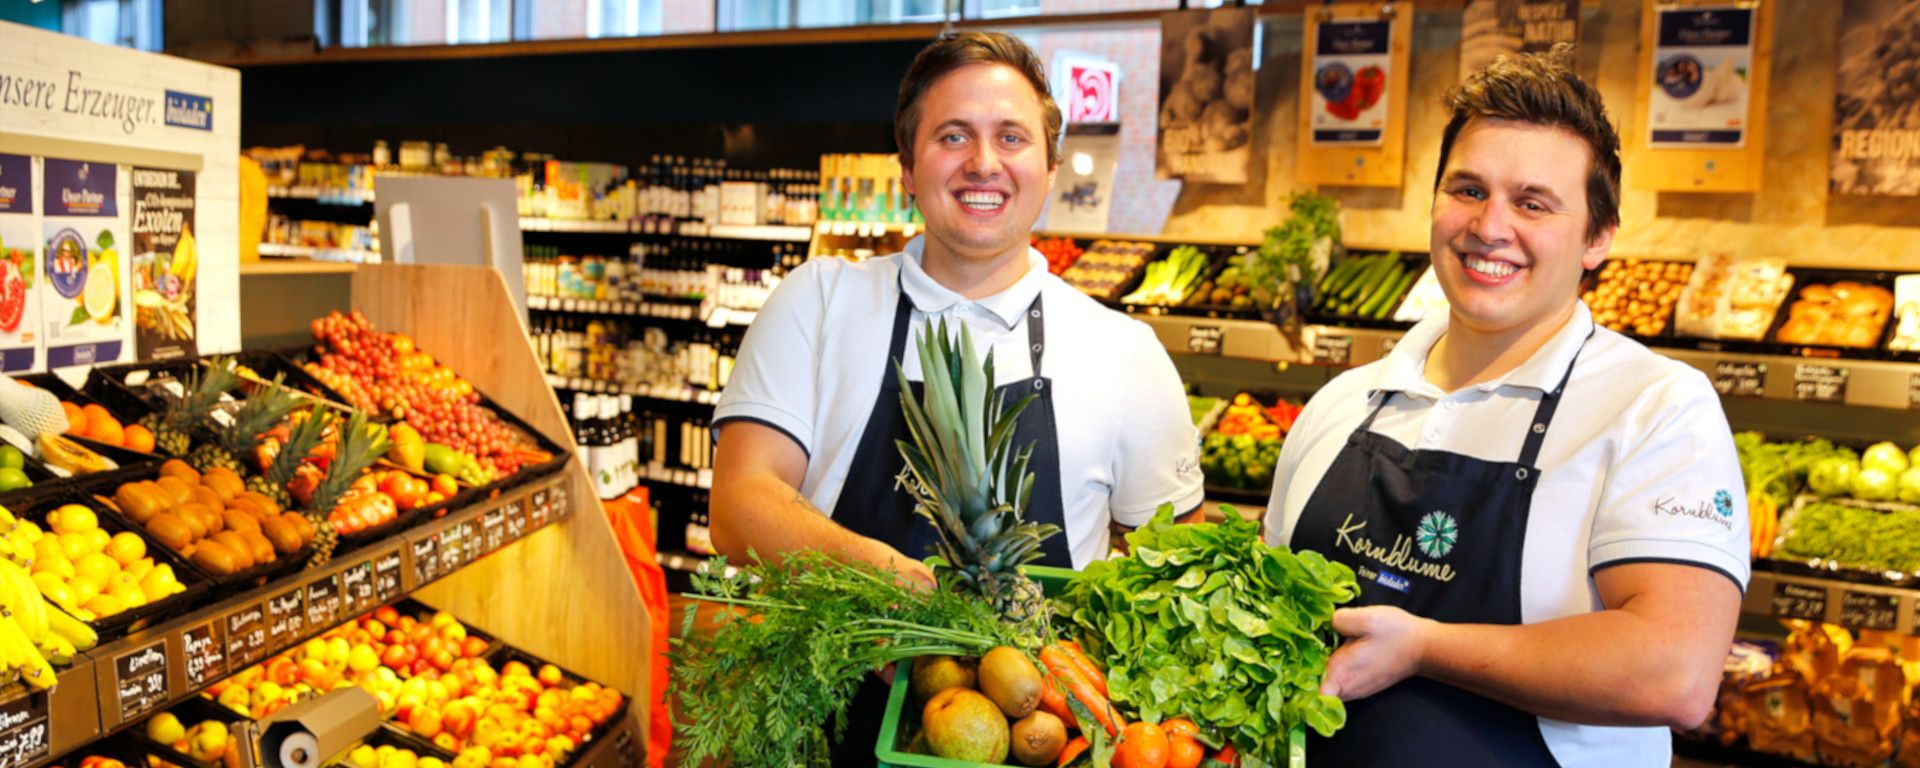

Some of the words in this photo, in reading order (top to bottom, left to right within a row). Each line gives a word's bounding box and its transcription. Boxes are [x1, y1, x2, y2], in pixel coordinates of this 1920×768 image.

[63, 70, 156, 135] Erzeuger.
[133, 199, 184, 233] Exoten
[1335, 512, 1457, 582] Kornblume
